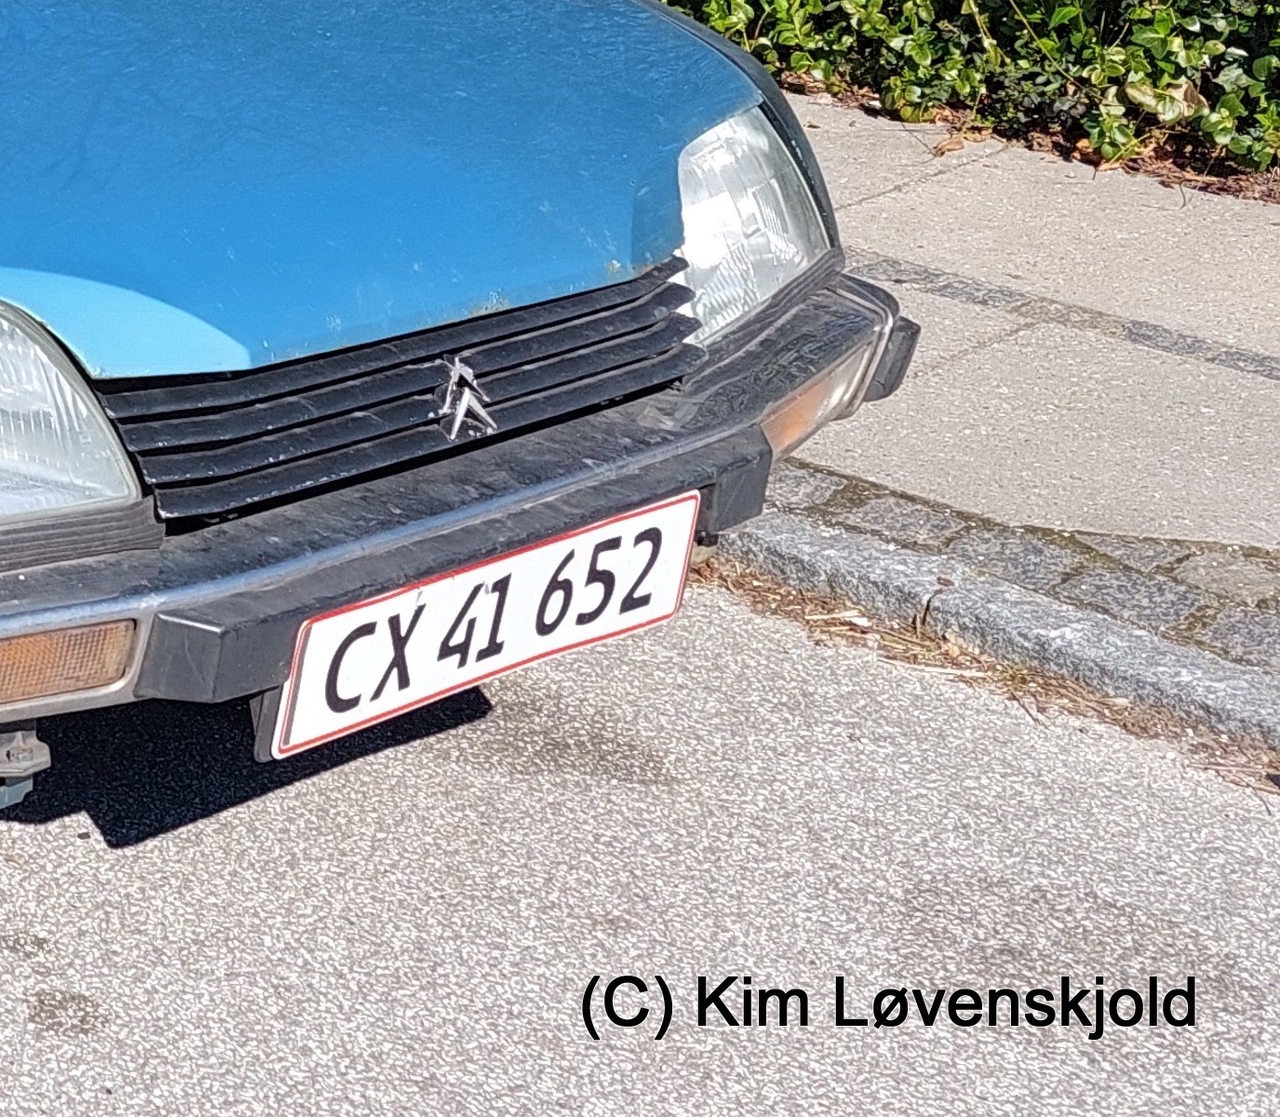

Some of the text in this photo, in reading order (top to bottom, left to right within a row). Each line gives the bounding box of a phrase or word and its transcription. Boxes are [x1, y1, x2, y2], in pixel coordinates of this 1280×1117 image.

[325, 527, 662, 713] CX 41 652
